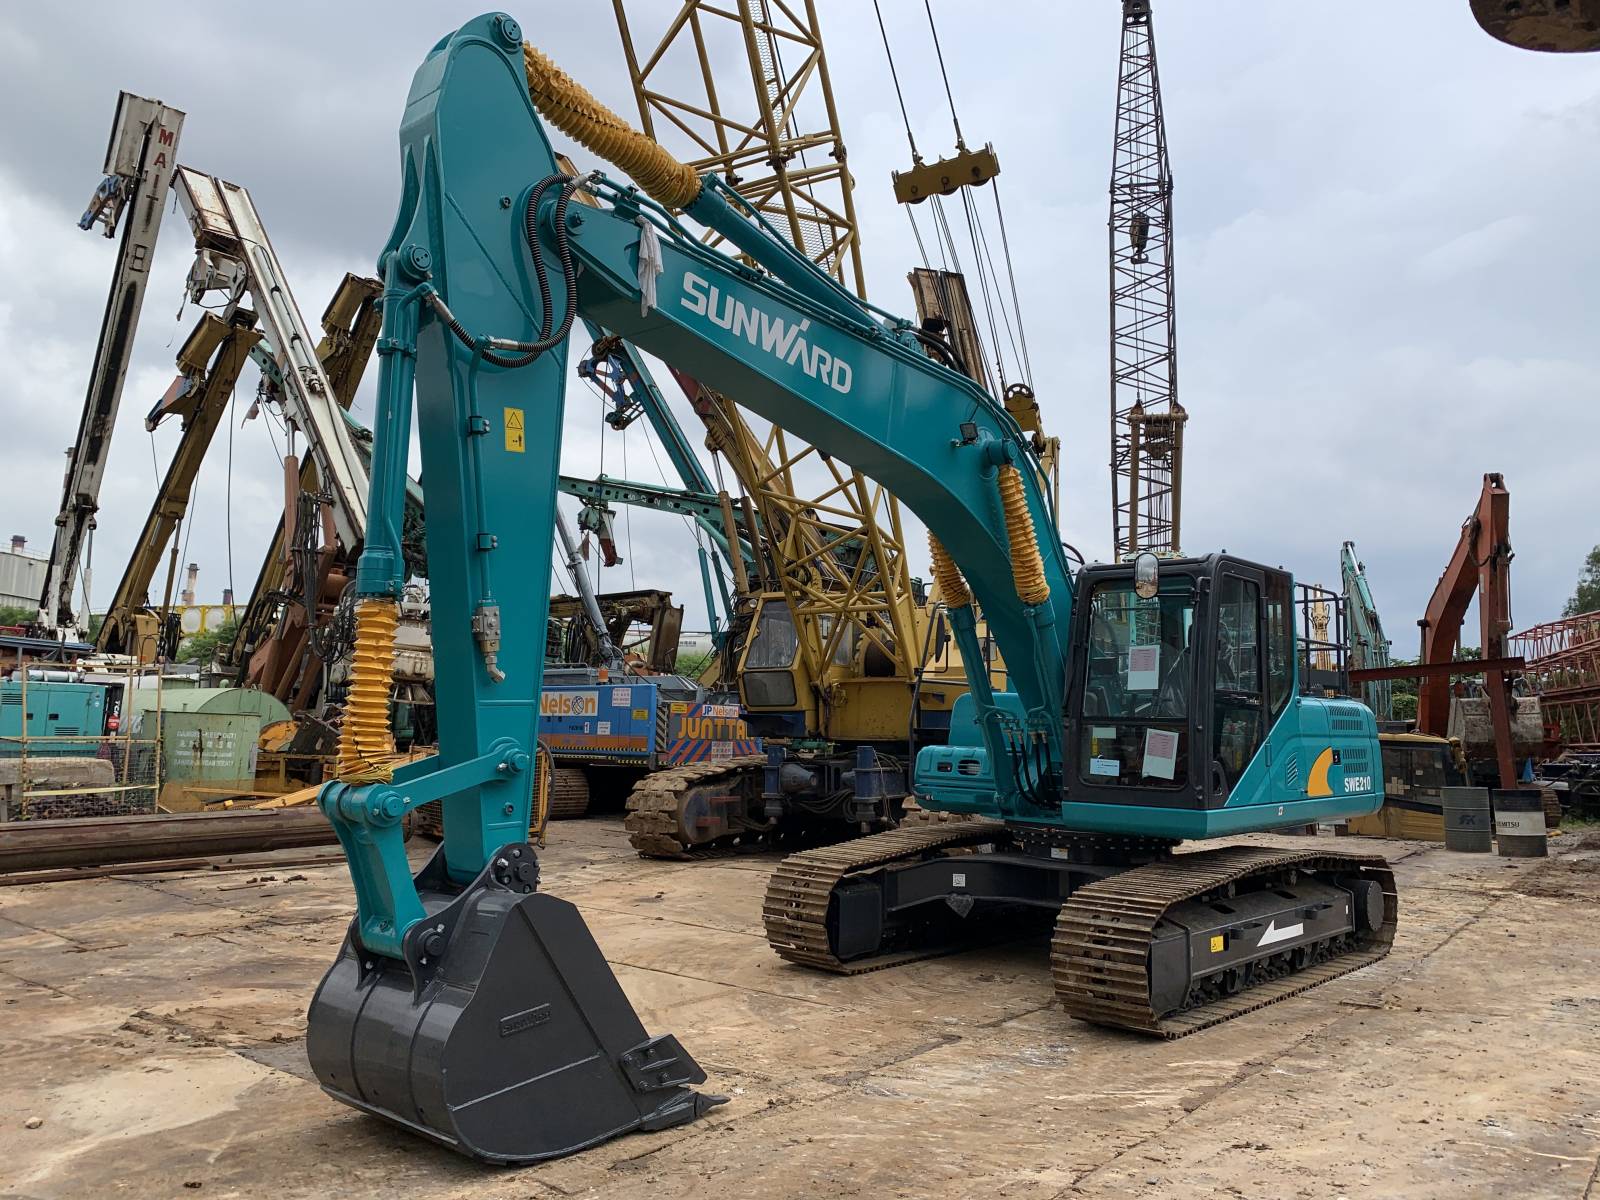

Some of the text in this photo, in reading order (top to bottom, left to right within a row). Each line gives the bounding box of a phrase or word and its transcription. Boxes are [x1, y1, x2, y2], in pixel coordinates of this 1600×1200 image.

[680, 271, 853, 394] SUNWARD
[703, 705, 713, 716] JP
[677, 717, 748, 740] JUNTTA
[1344, 775, 1371, 793] SWE210
